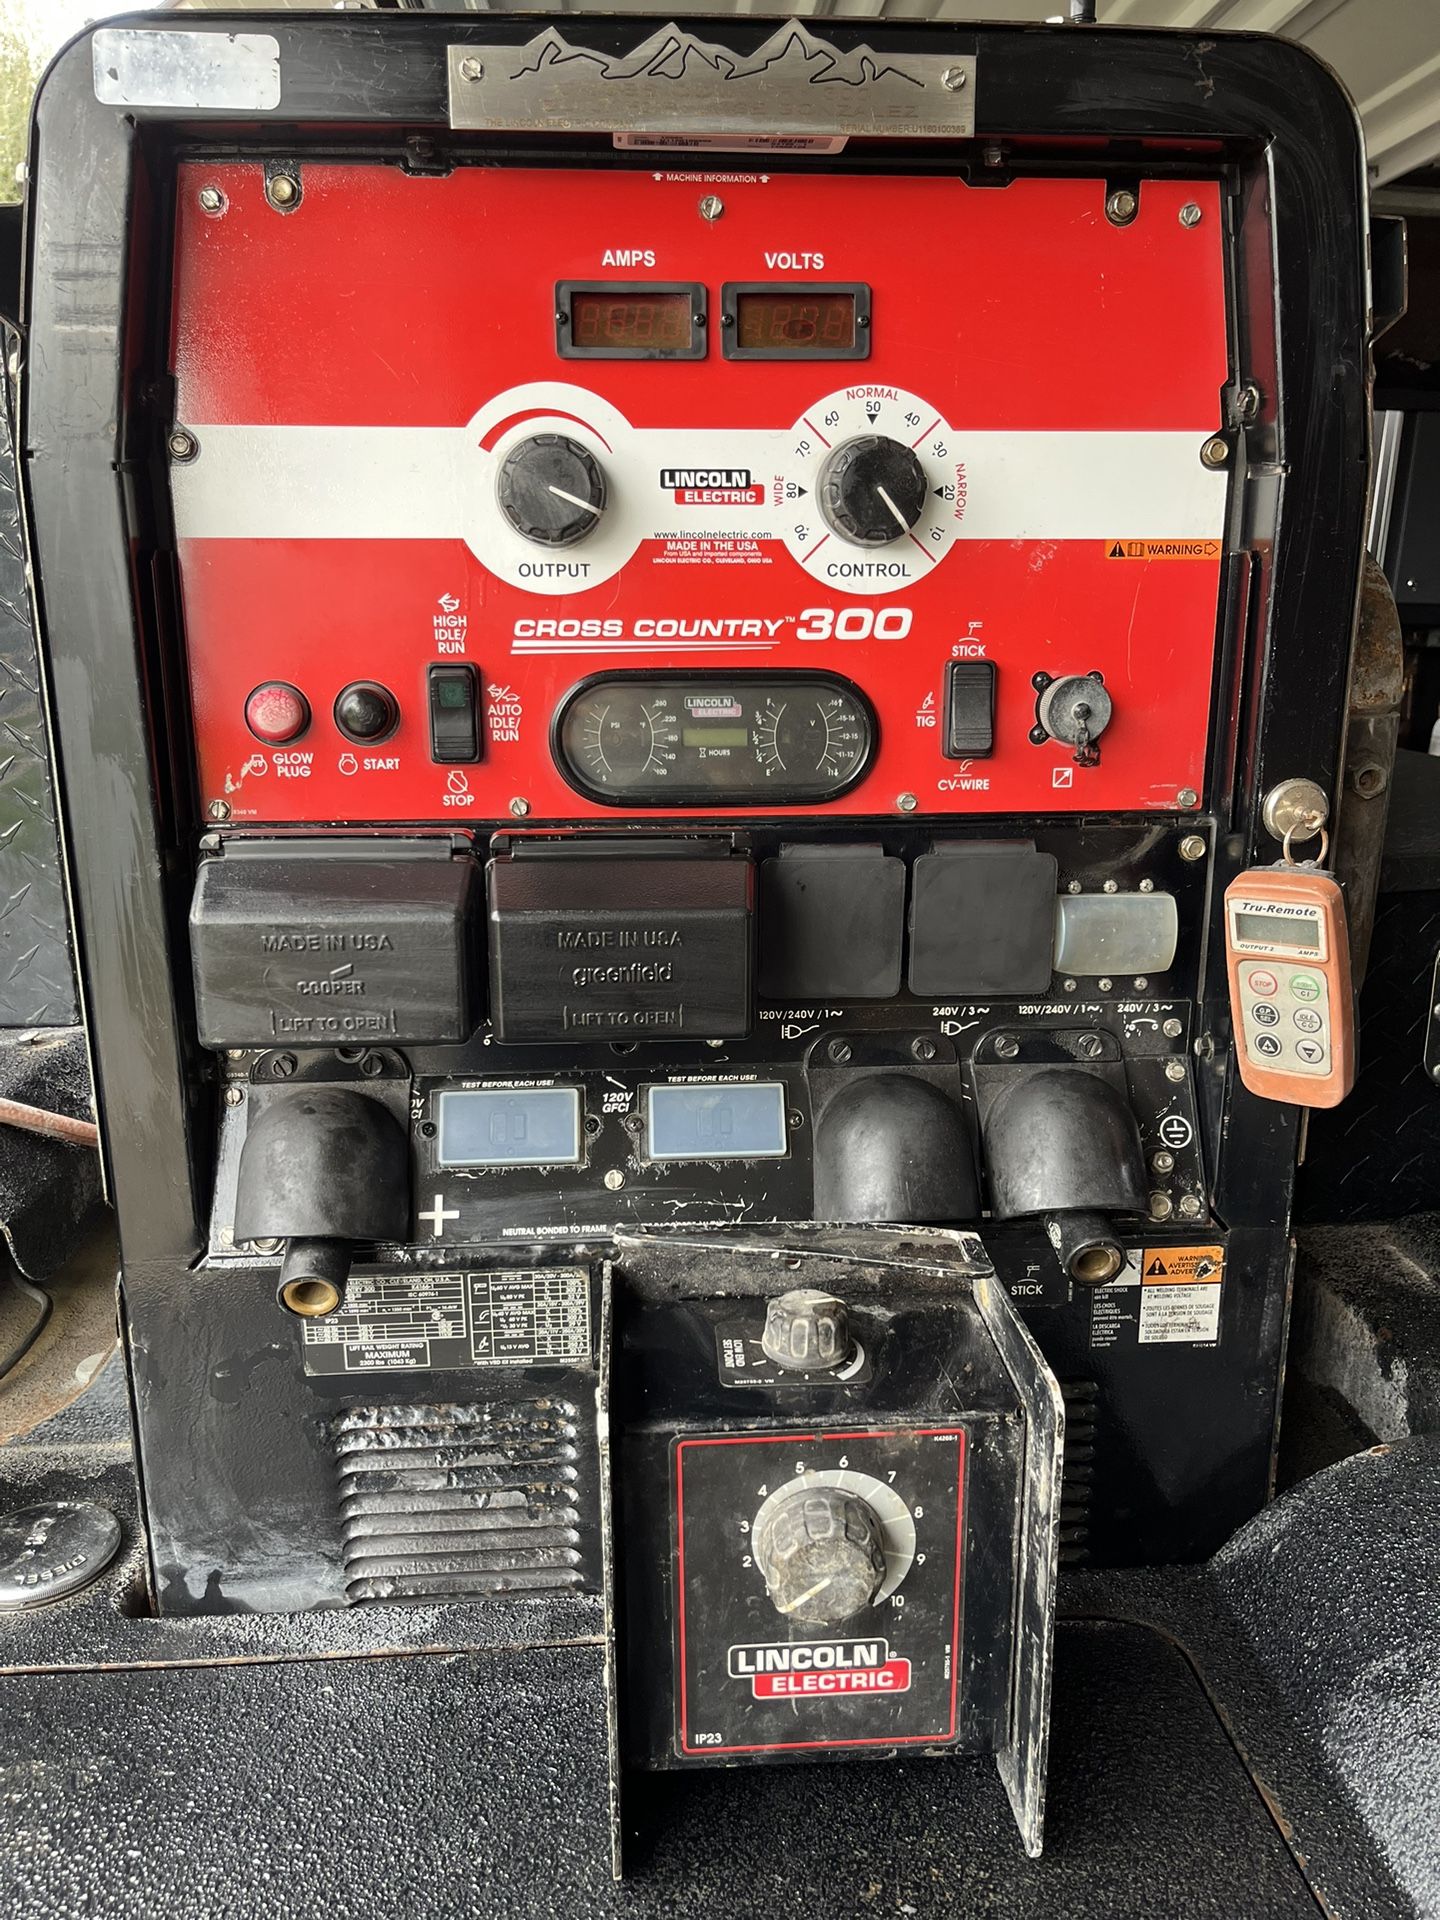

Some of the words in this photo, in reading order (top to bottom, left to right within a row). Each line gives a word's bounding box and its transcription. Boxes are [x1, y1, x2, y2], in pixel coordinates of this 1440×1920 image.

[840, 124, 872, 134] SERIAL
[667, 174, 702, 182] MACHINE
[704, 174, 756, 184] INFORMATION
[602, 250, 656, 267] AMPS
[764, 252, 825, 270] VOLTS
[846, 387, 899, 401] NORMAL
[866, 402, 881, 412] 50
[824, 410, 840, 426] 60
[904, 411, 920, 426] 40
[795, 440, 810, 457] 70
[934, 442, 947, 458] 30
[664, 472, 746, 488] LINCOLN
[774, 475, 784, 506] WIDE
[786, 482, 797, 498] 80
[944, 484, 955, 500] 20
[954, 463, 967, 520] NARROW
[684, 491, 757, 503] ELECTRIC
[654, 530, 772, 540] www.lincolnelectric.com
[794, 524, 808, 541] 90
[931, 527, 945, 542] 10
[666, 542, 699, 550] MADE
[700, 542, 711, 550] IN
[714, 542, 734, 550] THE
[736, 542, 758, 550] USA
[1147, 544, 1203, 556] WARNING
[518, 562, 591, 578] OUTPUT
[826, 563, 912, 578] CONTROL
[433, 616, 468, 627] HIGH
[514, 620, 624, 637] CROSS
[797, 608, 914, 640] 300
[434, 628, 467, 642] IDLE/
[438, 642, 465, 653] RUN
[952, 645, 986, 657] STICK
[687, 698, 732, 708] LINCOLN
[488, 704, 522, 716] AUTO
[696, 708, 738, 716] ELECTRIC
[489, 718, 520, 730] IDLE/
[916, 716, 936, 728] TIG
[492, 730, 519, 741] RUN
[272, 753, 314, 764] GLOW
[364, 758, 400, 770] START
[278, 765, 312, 777] PLUG
[938, 778, 990, 790] CV-WIRE
[442, 795, 474, 806] STOP
[1242, 902, 1317, 917] Tru-Remote
[261, 935, 320, 952] MADE
[326, 934, 346, 951] IN
[351, 934, 394, 950] USA
[557, 932, 613, 948] MADE
[619, 932, 638, 948] IN
[644, 930, 684, 948] USA
[572, 962, 674, 986] greenfield
[298, 980, 366, 996] COOPER
[1254, 980, 1273, 988] STOP
[932, 1008, 960, 1016] 240V
[1018, 1006, 1074, 1015] 120V/240V
[1117, 1004, 1144, 1013] 240V
[572, 1011, 603, 1025] LIFT
[606, 1010, 630, 1024] TO
[634, 1010, 676, 1024] OPEN
[758, 1011, 814, 1019] 120V/240V
[279, 1019, 313, 1032] LIFT
[320, 1018, 338, 1030] TO
[344, 1016, 387, 1030] OPEN
[515, 1080, 536, 1088] EACH
[538, 1080, 555, 1088] USE!
[602, 1092, 634, 1103] 120V
[602, 1102, 632, 1114] GFCI
[503, 1226, 536, 1236] NEUTRAL
[537, 1226, 570, 1236] BONDED
[571, 1225, 580, 1234] TO
[581, 1225, 608, 1234] FRAME
[1010, 1284, 1044, 1295] STICK
[722, 1340, 734, 1351] SET
[734, 1340, 744, 1354] LOW
[365, 1351, 410, 1360] MAXIMUM
[724, 1350, 736, 1368] POINT
[735, 1353, 746, 1368] END
[796, 1462, 805, 1474] 5
[840, 1456, 849, 1468] 6
[888, 1472, 897, 1483] 7
[758, 1485, 768, 1496] 4
[915, 1507, 924, 1518] 8
[740, 1522, 750, 1533] 3
[742, 1557, 752, 1568] 2
[916, 1554, 926, 1566] 9
[14, 1554, 87, 1586] DIESEL
[891, 1596, 905, 1608] 10
[738, 1644, 878, 1673] LINCOLN
[772, 1671, 894, 1692] ELECTRIC
[696, 1734, 723, 1744] IP23
